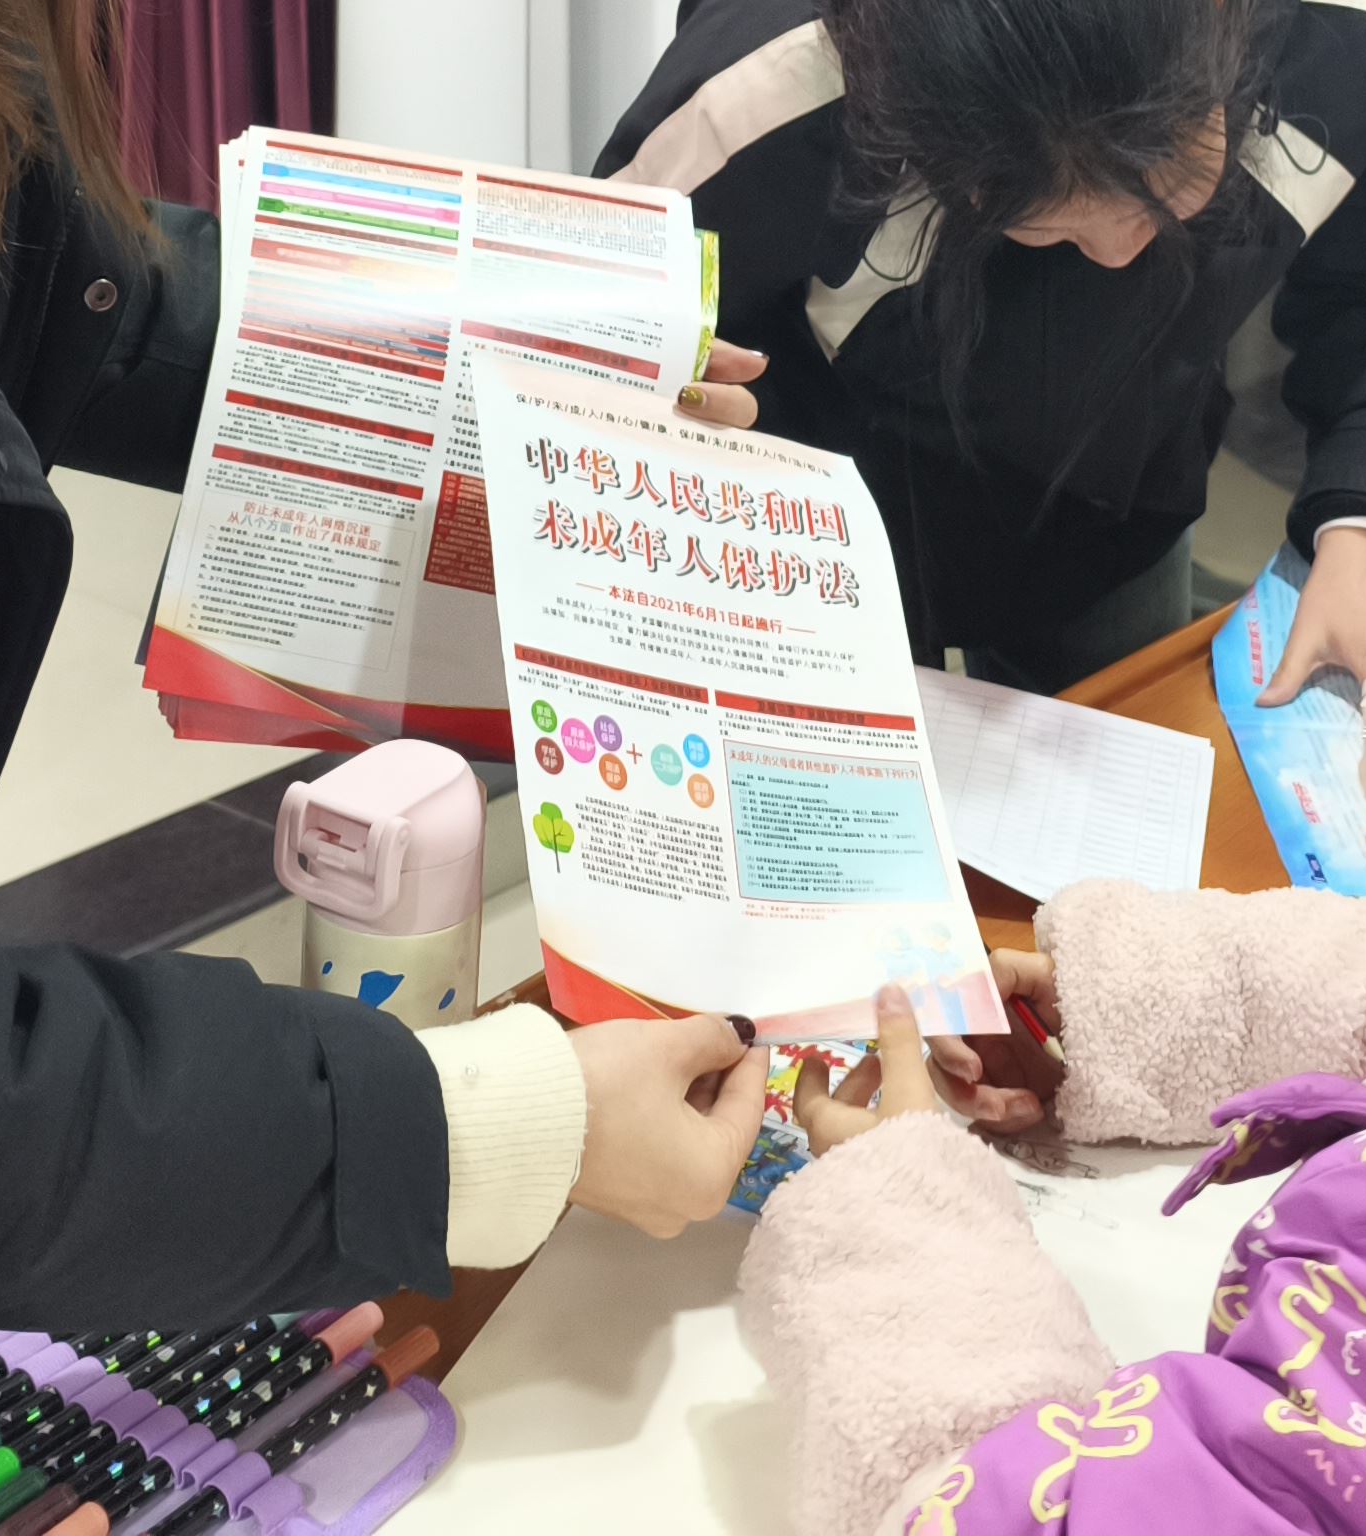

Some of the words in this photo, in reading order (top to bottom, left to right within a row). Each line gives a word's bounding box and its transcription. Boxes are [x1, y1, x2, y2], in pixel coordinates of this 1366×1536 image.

[524, 435, 851, 547] 中华人民共和国
[533, 497, 861, 608] 未成年人保护法
[607, 583, 784, 635] 本法自2021年6月1日起施行
